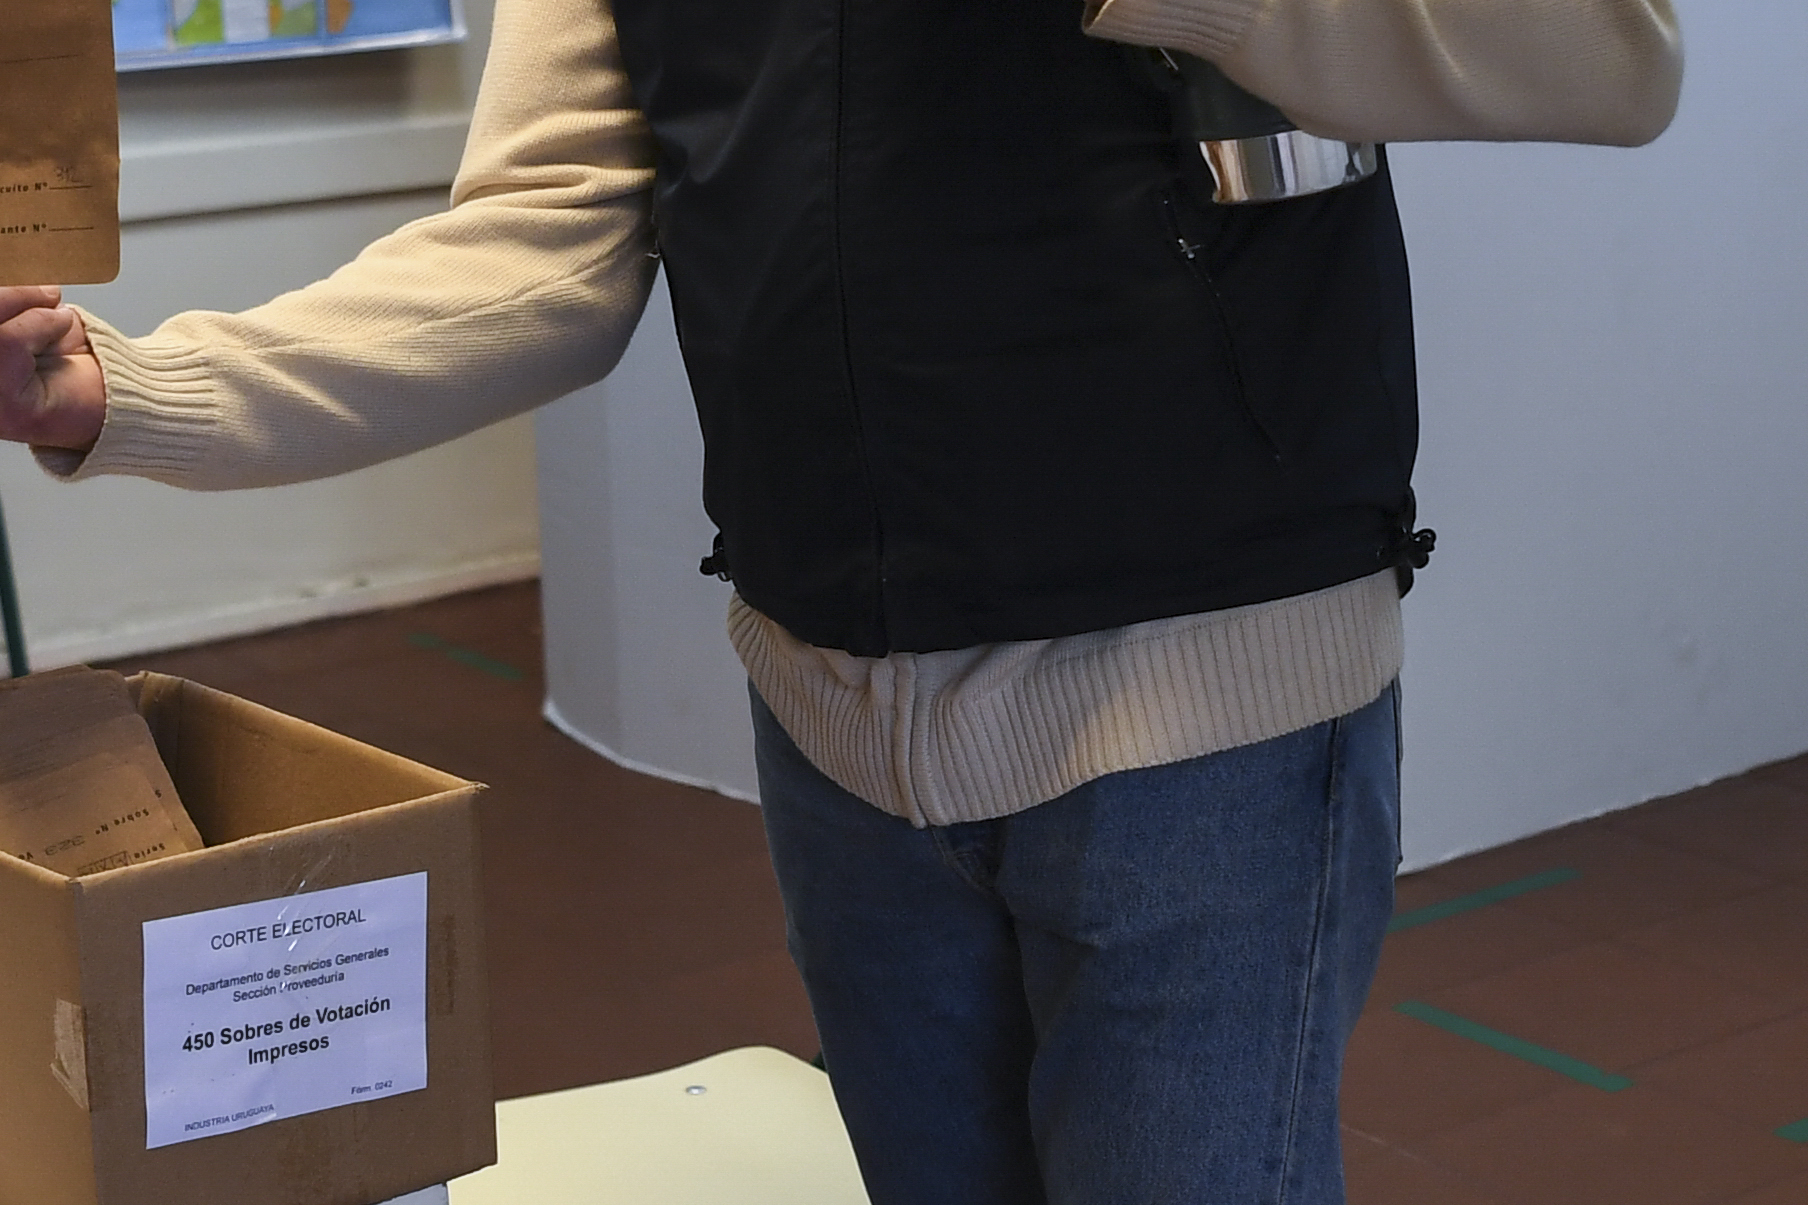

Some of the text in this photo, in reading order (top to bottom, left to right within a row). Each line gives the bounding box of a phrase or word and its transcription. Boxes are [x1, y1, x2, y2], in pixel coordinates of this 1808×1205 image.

[113, 808, 150, 826] Sobre
[133, 842, 166, 859] Serie
[211, 908, 367, 950] CORTE ELECTORAL
[186, 947, 390, 996] Departamento de Servicios Generales
[233, 985, 277, 1003] Sección
[182, 996, 391, 1052] 450 Sobres de Votación
[248, 1035, 330, 1065] Impresos
[184, 1103, 275, 1132] INDUSTRIA URUGUAYA
